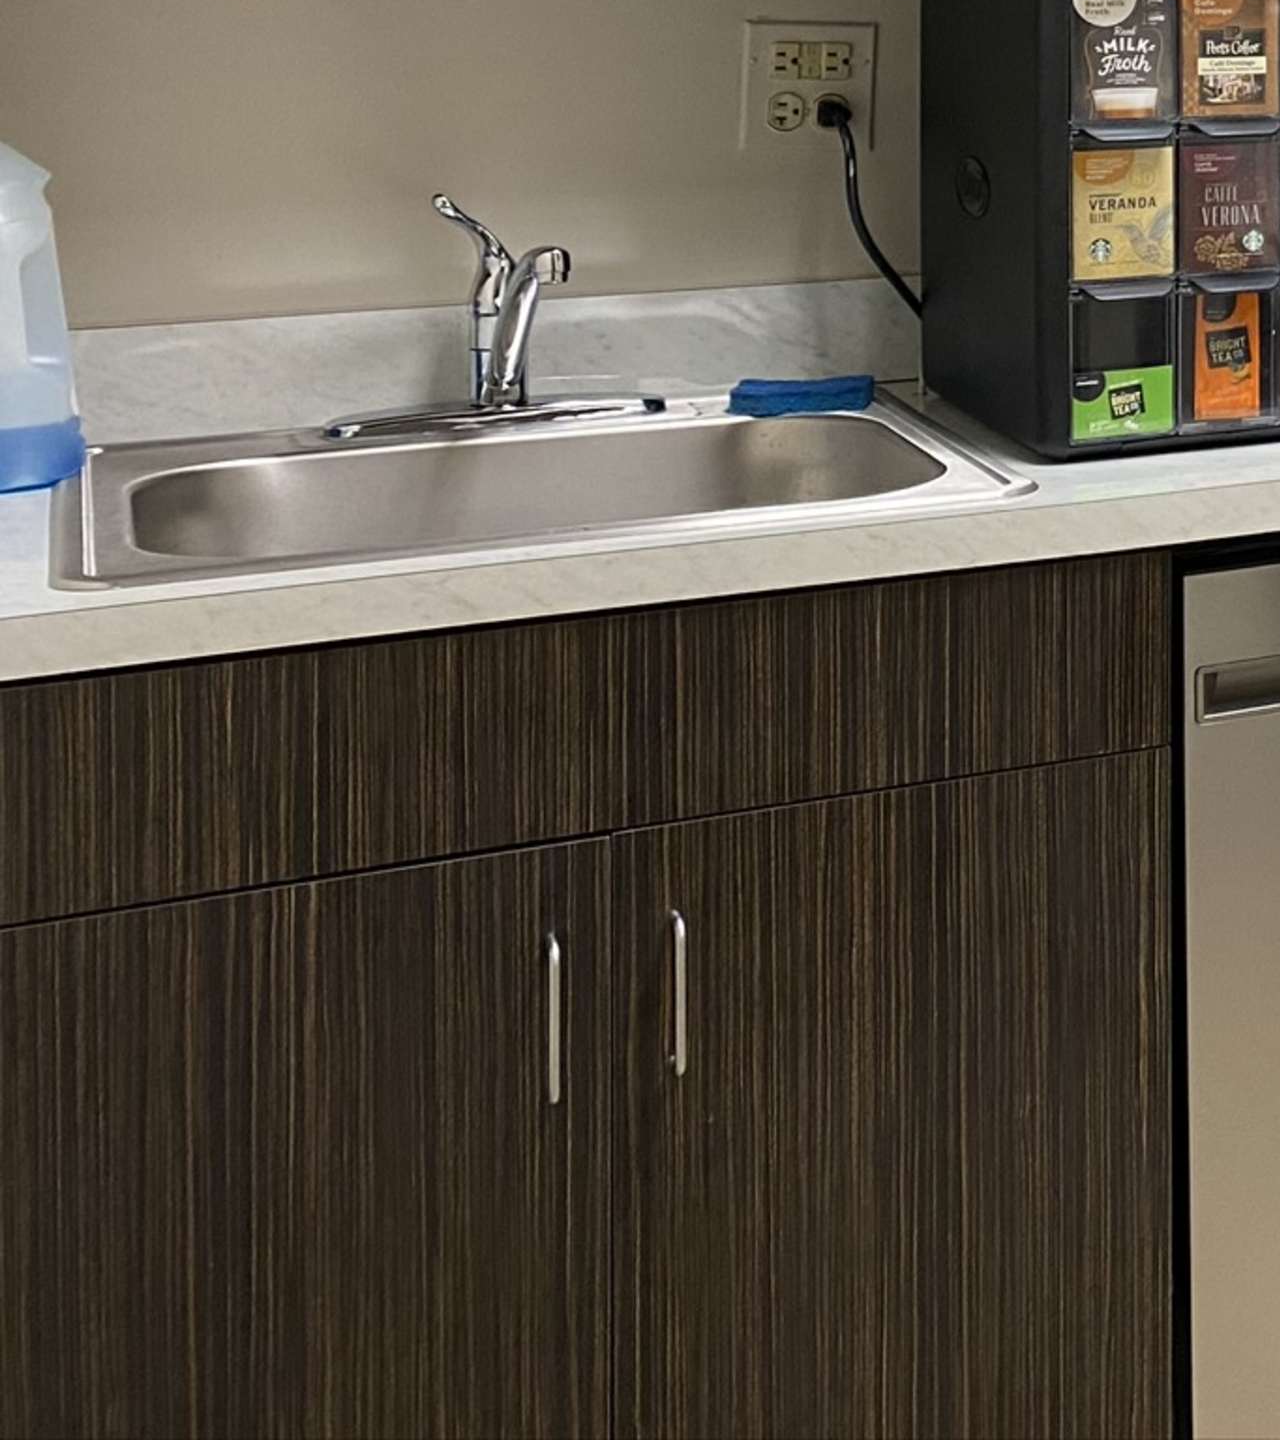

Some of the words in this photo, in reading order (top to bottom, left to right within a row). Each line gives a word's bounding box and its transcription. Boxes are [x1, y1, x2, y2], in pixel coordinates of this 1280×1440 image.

[1102, 36, 1151, 54] MILK
[1098, 53, 1152, 76] Froth
[1089, 196, 1158, 212] VERANDA
[1201, 204, 1261, 227] VERONA
